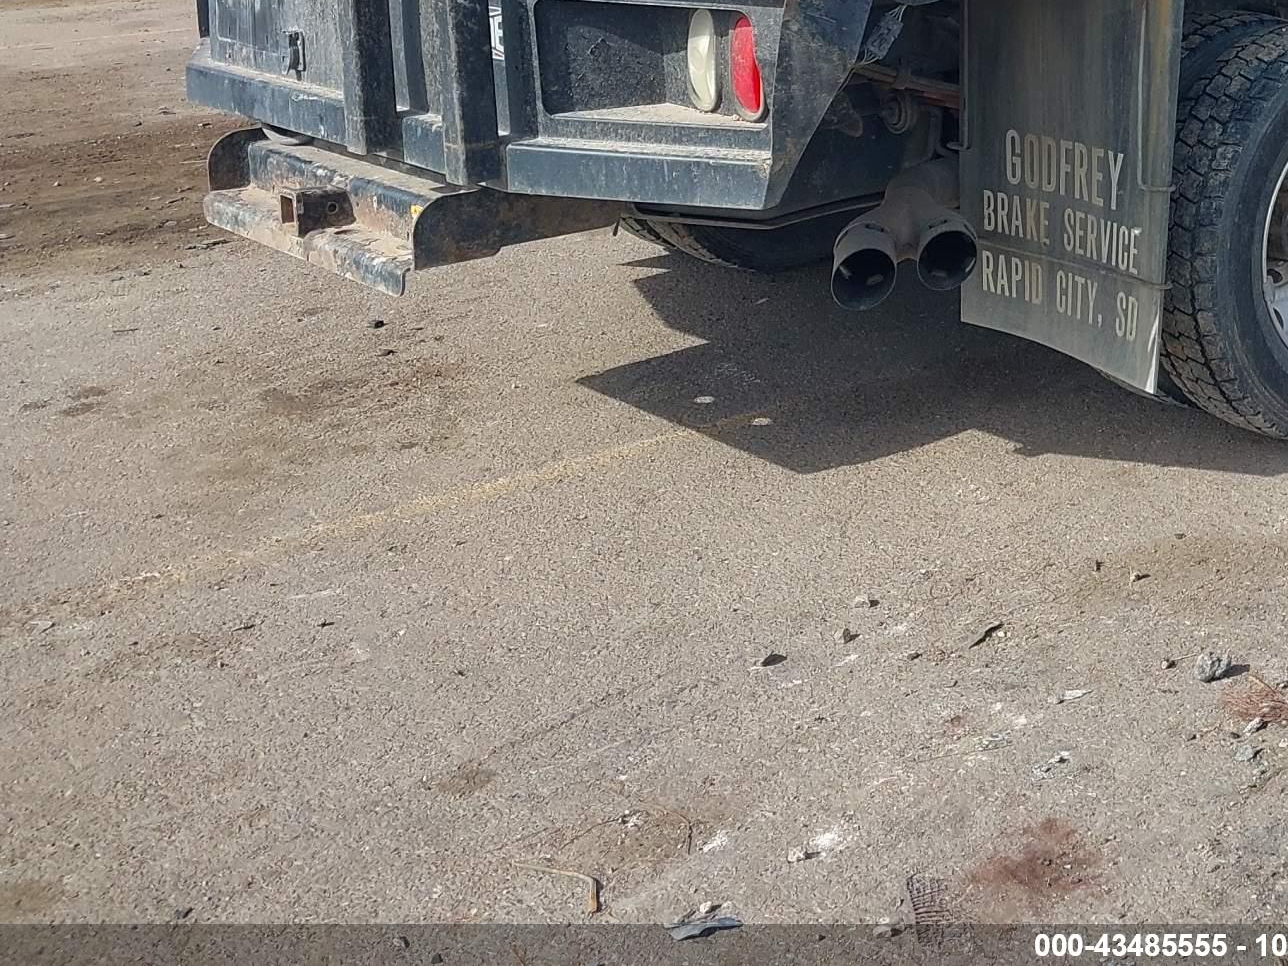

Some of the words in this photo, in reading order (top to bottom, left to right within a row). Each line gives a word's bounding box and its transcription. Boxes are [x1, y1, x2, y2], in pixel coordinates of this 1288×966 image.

[1005, 129, 1124, 211] GODFREY
[983, 189, 1050, 247] BRAKE
[1063, 208, 1142, 274] SERVICE
[982, 250, 1043, 305] RAPID
[1056, 270, 1102, 328] CITY,
[1115, 291, 1139, 342] SD
